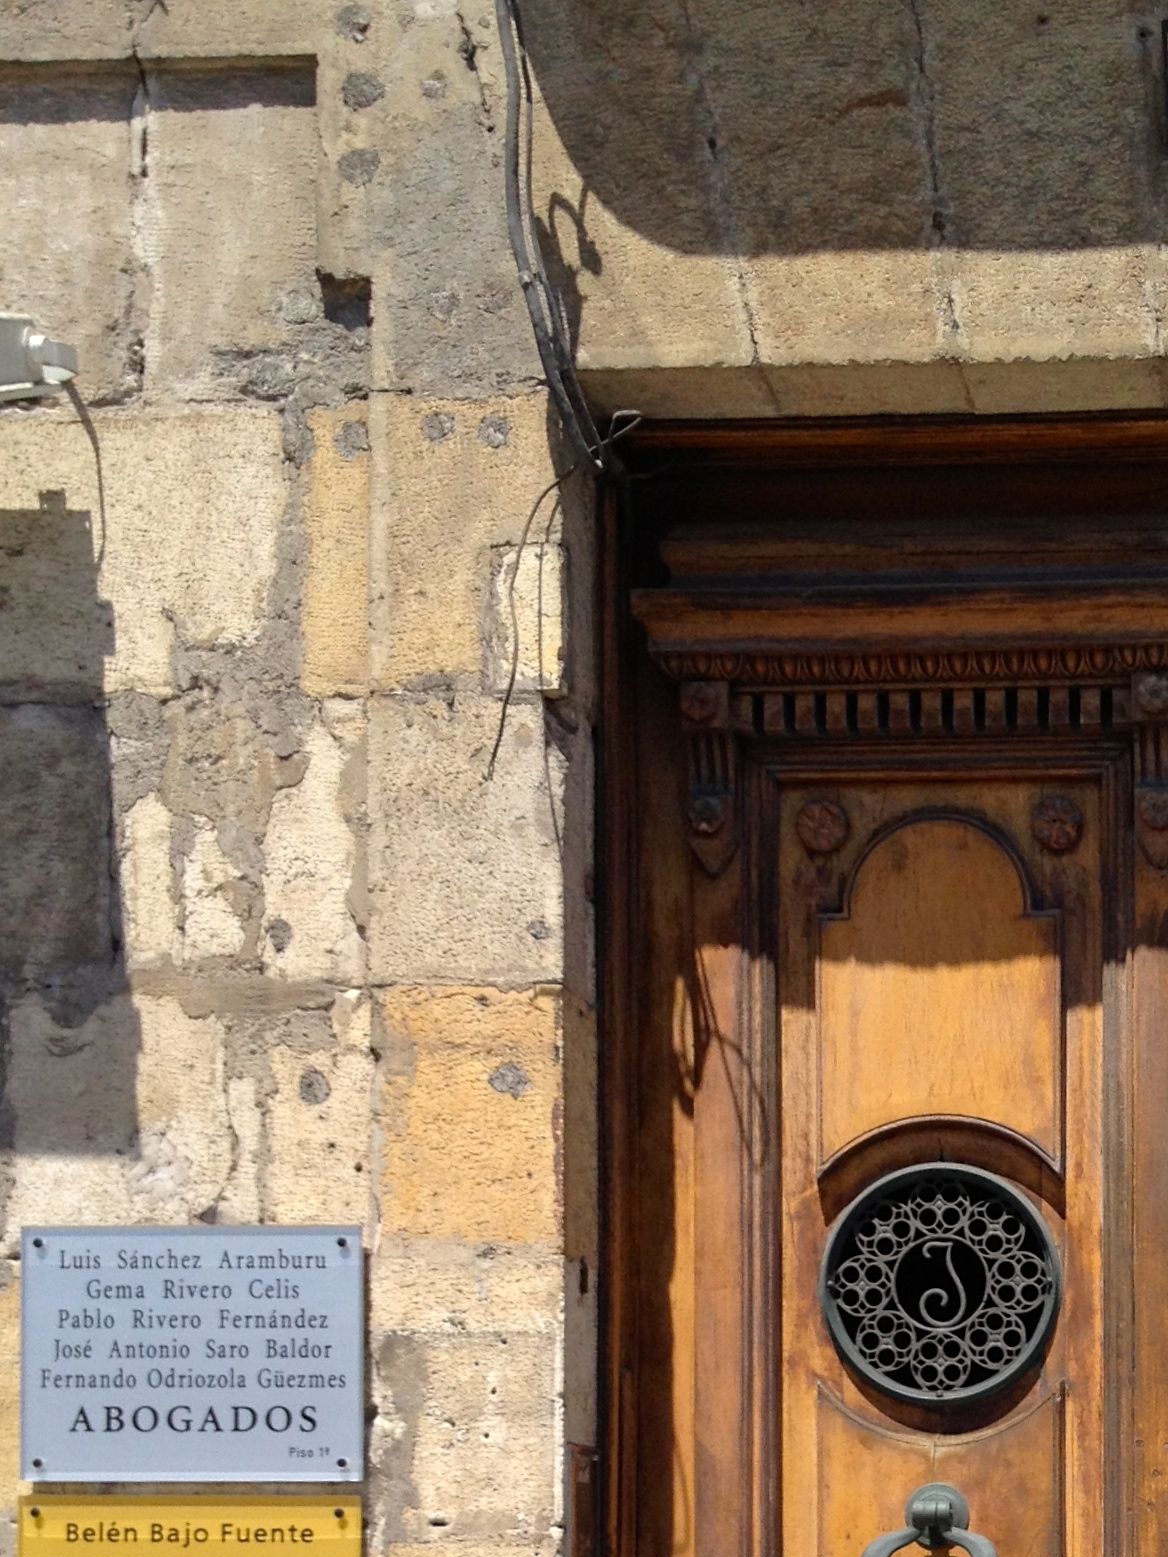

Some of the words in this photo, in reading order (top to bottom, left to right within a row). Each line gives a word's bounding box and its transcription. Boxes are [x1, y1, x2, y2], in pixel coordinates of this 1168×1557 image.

[60, 1251, 102, 1269] Luis
[117, 1250, 202, 1269] Sánchez
[219, 1251, 327, 1269] Aramburu
[87, 1280, 145, 1299] Gema
[164, 1280, 232, 1299] Rivero
[249, 1280, 300, 1299] Celis
[58, 1309, 115, 1329] Pablo
[133, 1309, 201, 1329] Rivero
[219, 1309, 329, 1329] Fernández
[54, 1339, 92, 1362] José
[109, 1339, 190, 1359] Antonio
[206, 1339, 249, 1359] Saro
[266, 1339, 333, 1359] Baldor
[40, 1369, 136, 1389] Fernando
[147, 1369, 246, 1389] Odriozola
[258, 1369, 346, 1389] Güezmes
[70, 1405, 318, 1433] ABOGADOS
[289, 1447, 313, 1458] Piso
[66, 1523, 138, 1542] Belén
[150, 1523, 208, 1548] Bajo
[221, 1524, 313, 1542] Fuente
